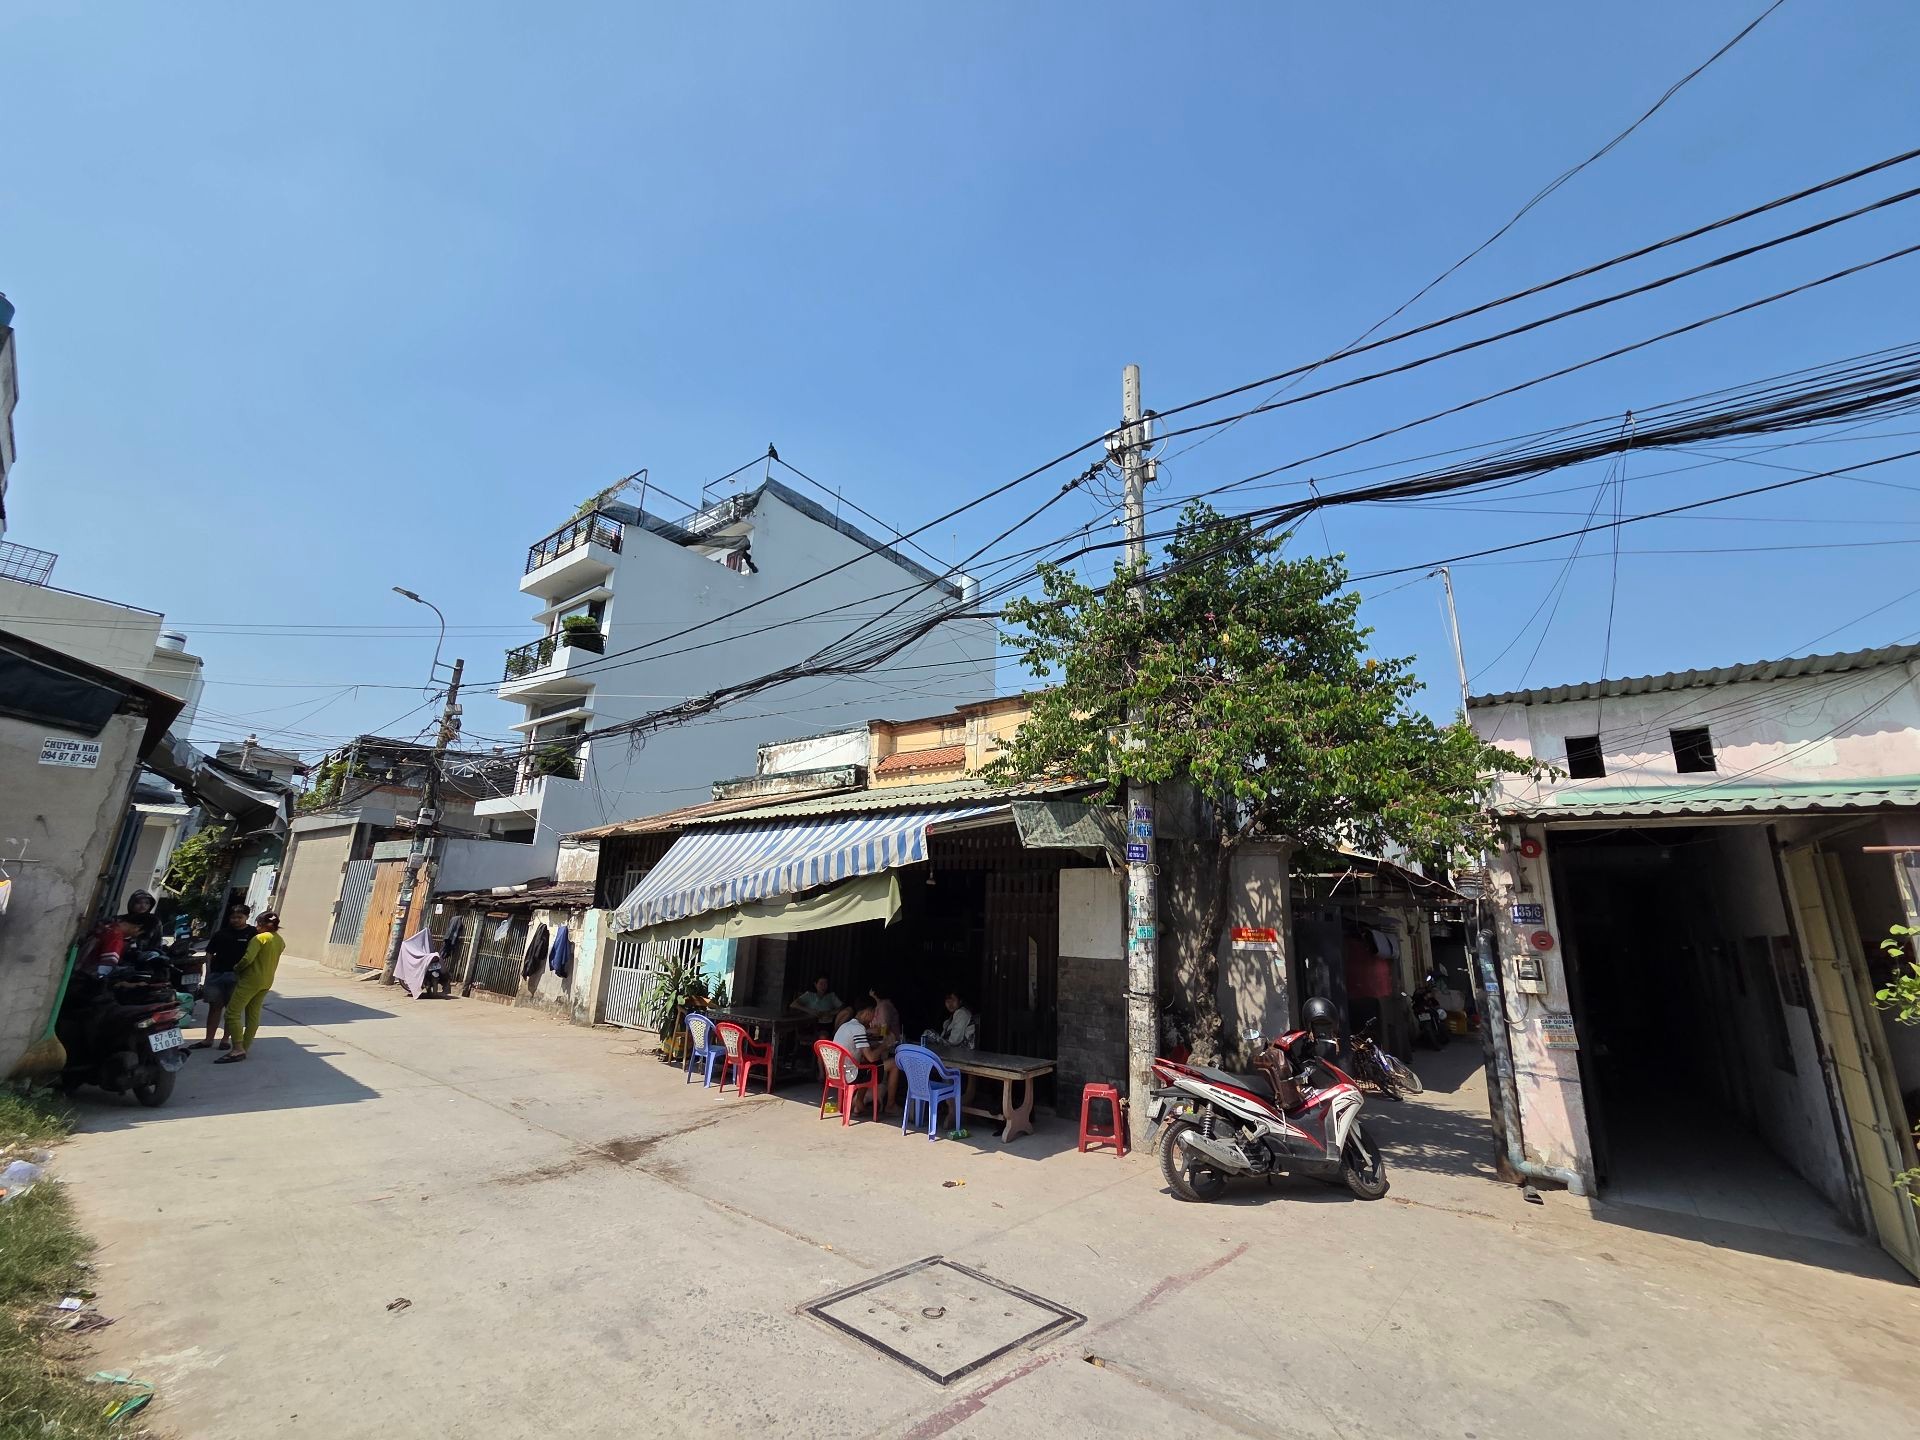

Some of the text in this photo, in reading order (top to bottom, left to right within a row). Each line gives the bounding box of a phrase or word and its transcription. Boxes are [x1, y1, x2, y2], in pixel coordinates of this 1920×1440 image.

[41, 750, 97, 764] 094 87 87 548
[1513, 905, 1541, 919] 135/6
